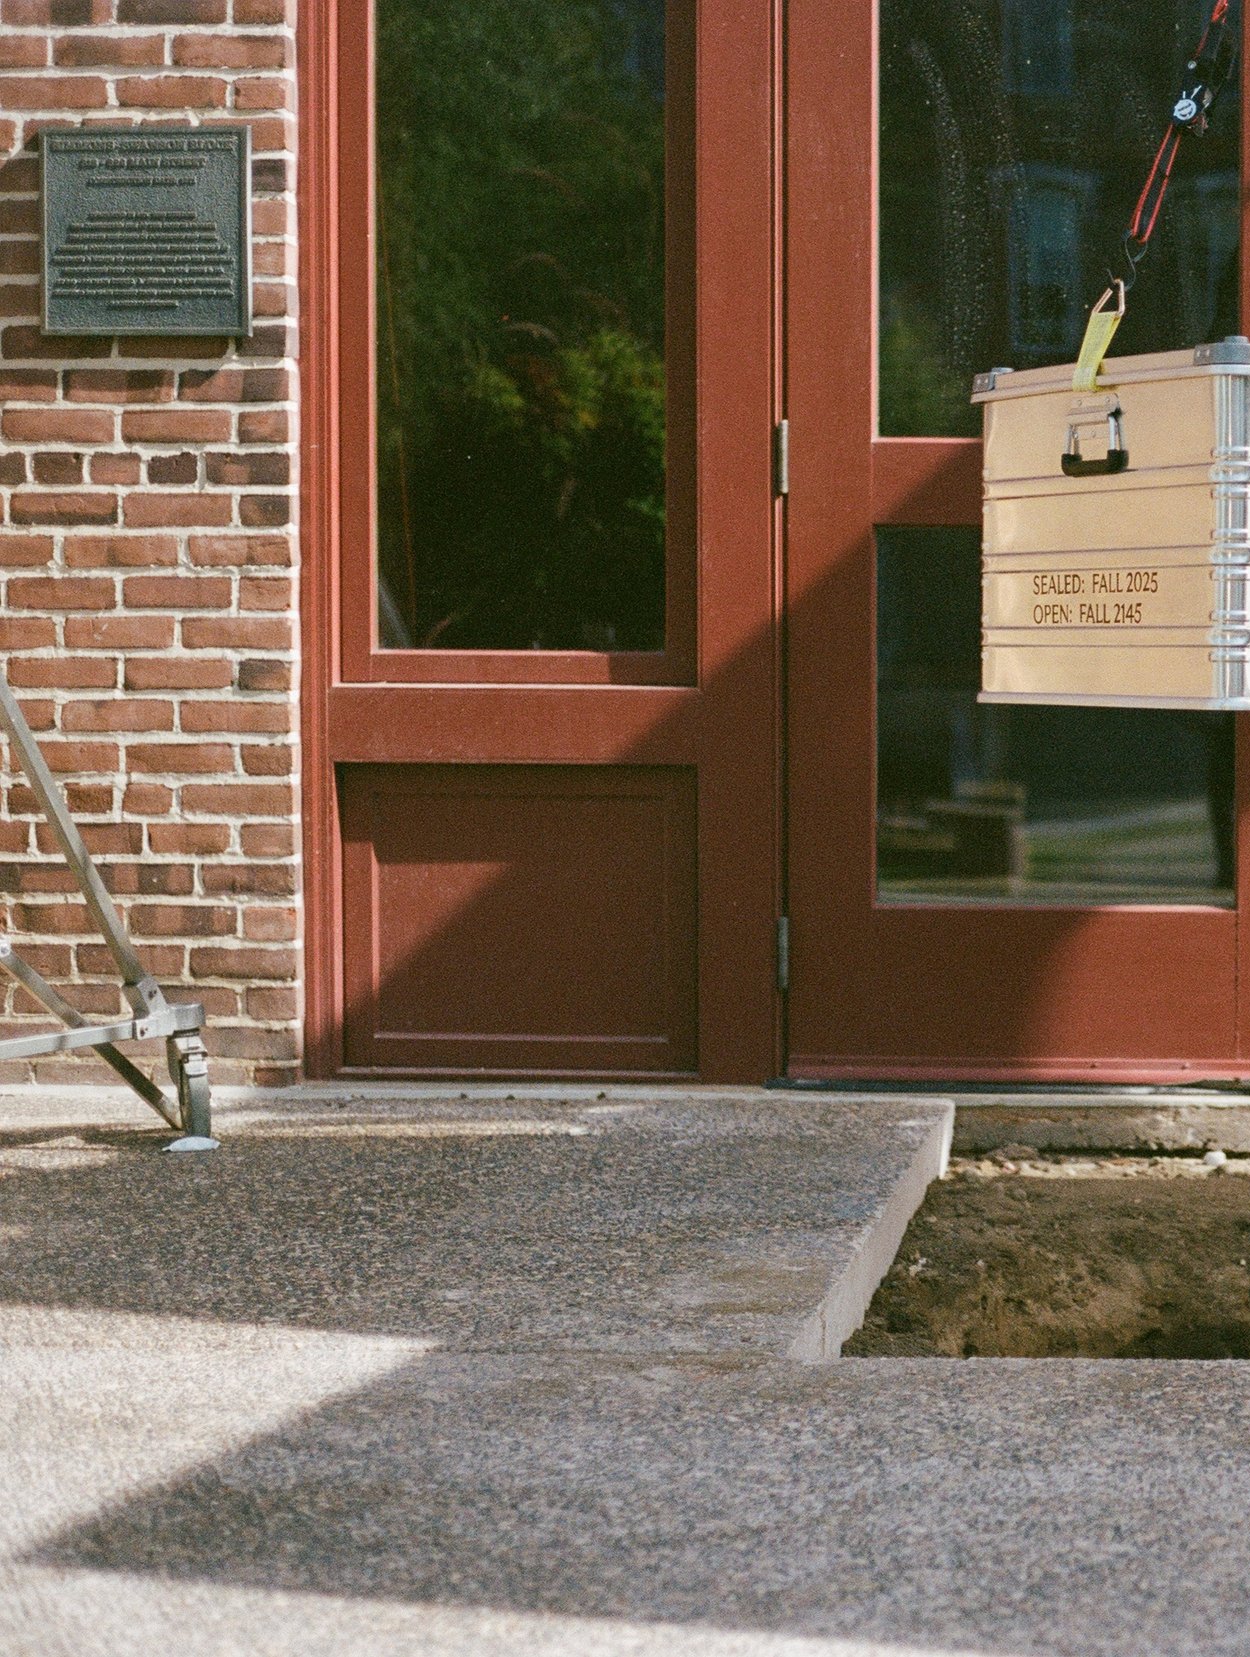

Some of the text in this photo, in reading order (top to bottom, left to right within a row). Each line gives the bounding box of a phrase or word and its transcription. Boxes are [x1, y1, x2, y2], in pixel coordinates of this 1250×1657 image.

[1033, 571, 1158, 595] SEALED: FALL 2025
[1033, 602, 1142, 624] OPEN: FALL 2145
